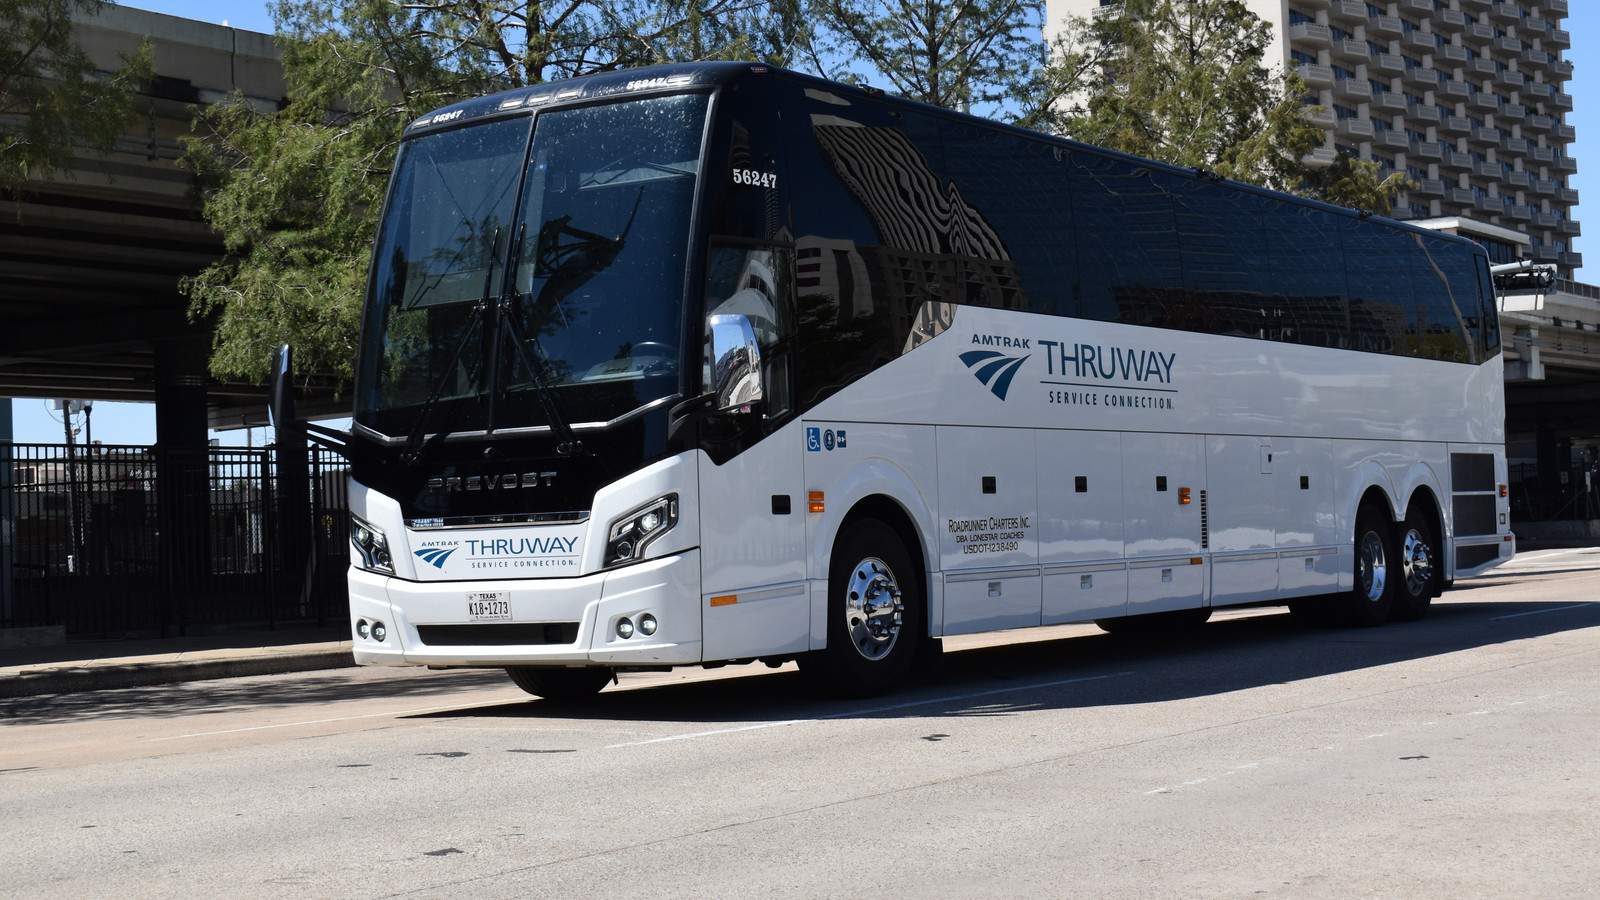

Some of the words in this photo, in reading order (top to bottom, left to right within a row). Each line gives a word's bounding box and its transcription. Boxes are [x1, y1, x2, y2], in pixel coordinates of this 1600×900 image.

[733, 168, 777, 189] 56247
[971, 333, 1030, 349] AMTRAK
[1038, 340, 1176, 384] THRUWAY
[1049, 391, 1097, 406] SERVICE
[428, 471, 557, 493] PREVOST
[956, 535, 968, 543] DBA
[970, 533, 999, 543] LONESTAR
[1000, 531, 1025, 540] COACHES
[465, 536, 578, 556] THRUWAY
[963, 541, 1019, 555] USDOT-1238490
[472, 561, 508, 569] SERVICE
